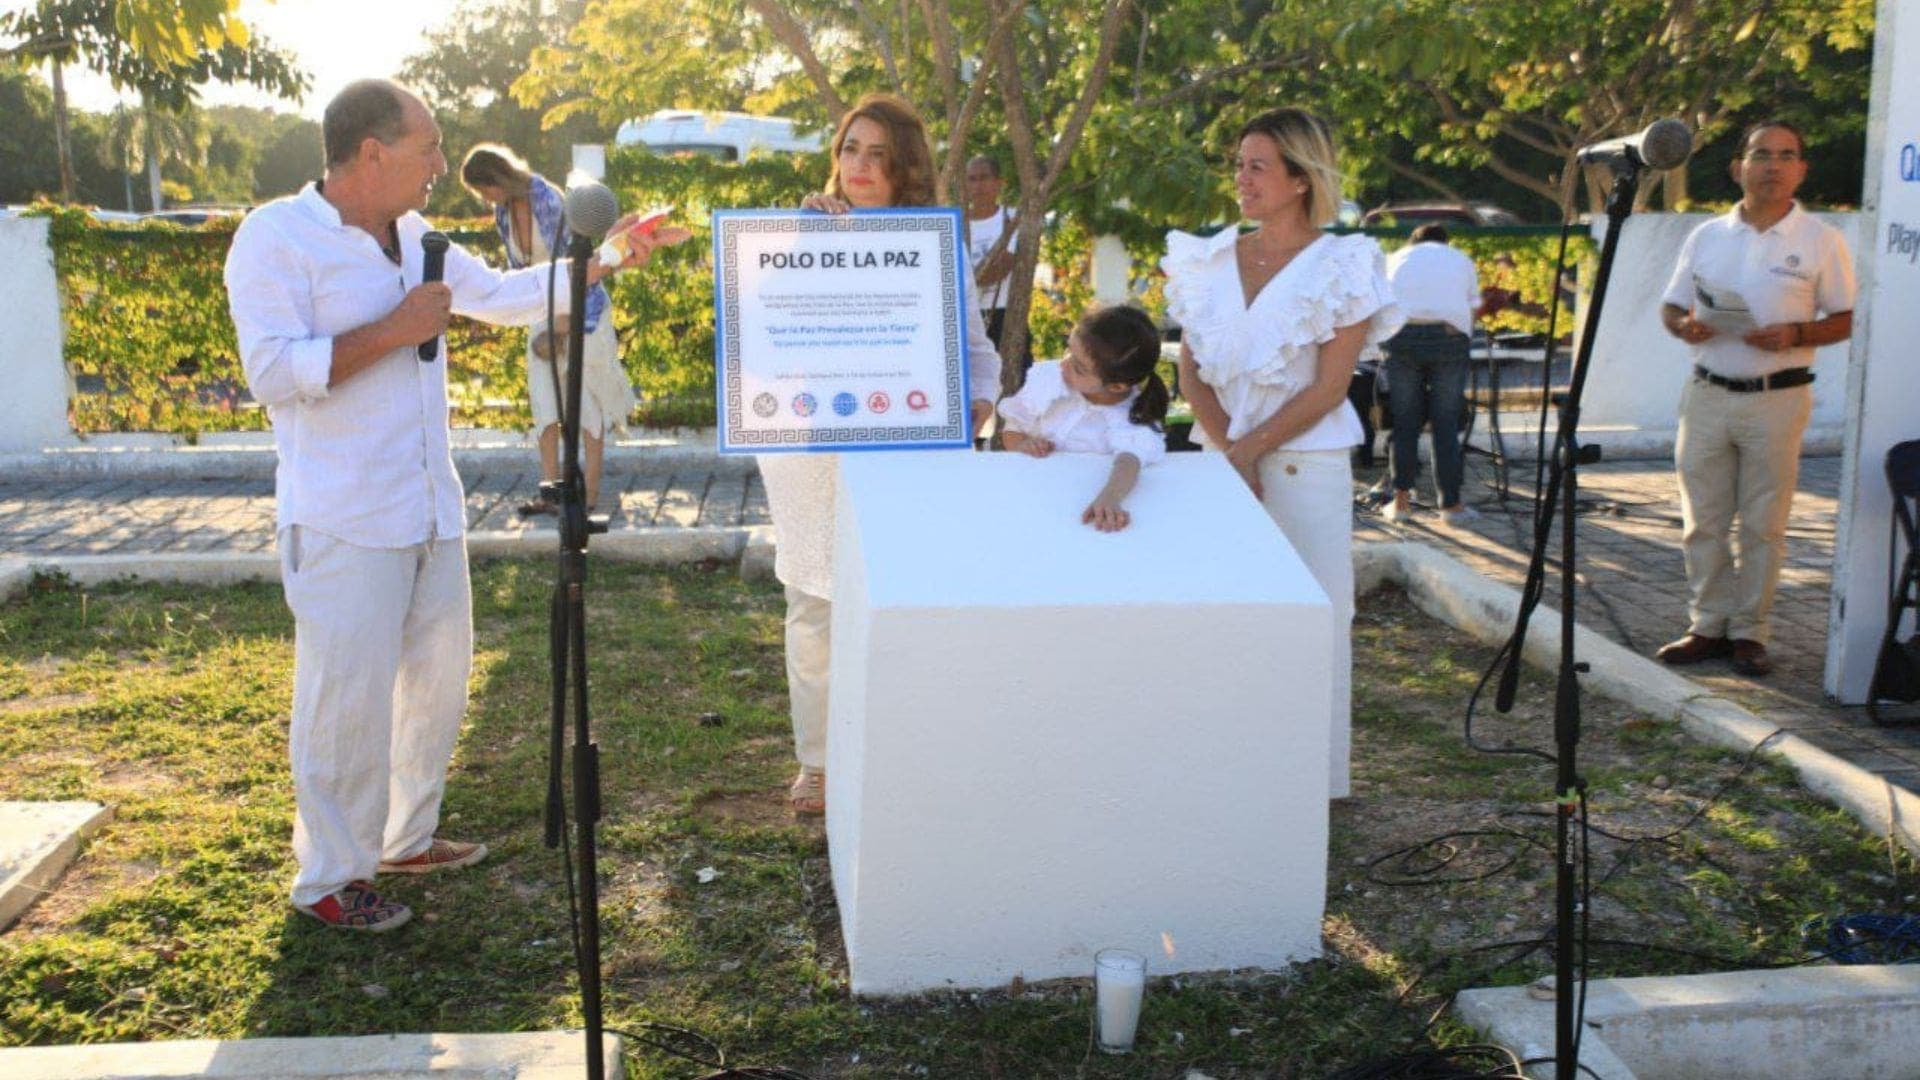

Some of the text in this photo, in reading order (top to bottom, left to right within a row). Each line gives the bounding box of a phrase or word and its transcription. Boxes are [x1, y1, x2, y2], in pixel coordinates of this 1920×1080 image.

[759, 251, 921, 269] POLO DE LA PAZ
